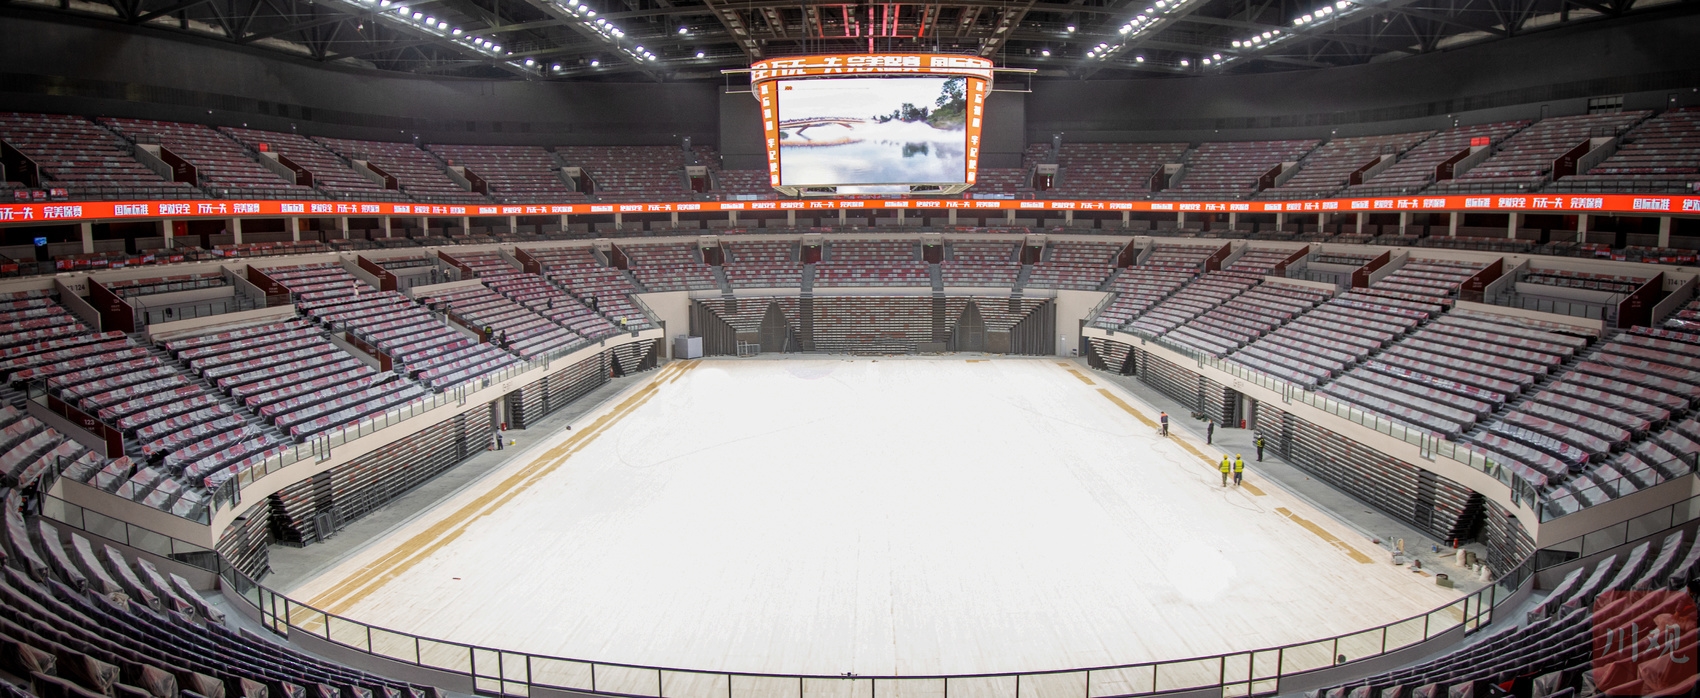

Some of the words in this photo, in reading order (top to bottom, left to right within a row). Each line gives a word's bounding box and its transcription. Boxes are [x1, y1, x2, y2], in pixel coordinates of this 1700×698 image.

[44, 206, 82, 218] 完美保赛
[115, 204, 148, 215] 国际标准
[160, 204, 190, 214] 绝对安全
[198, 204, 226, 213] 万无一失
[234, 203, 259, 213] 完美保赛
[1465, 198, 1490, 207] 国际标准
[1499, 198, 1526, 208] 绝对安全
[1533, 198, 1562, 208] 万无一失
[1571, 198, 1602, 208] 完美保赛
[1633, 199, 1669, 210] 国际标准
